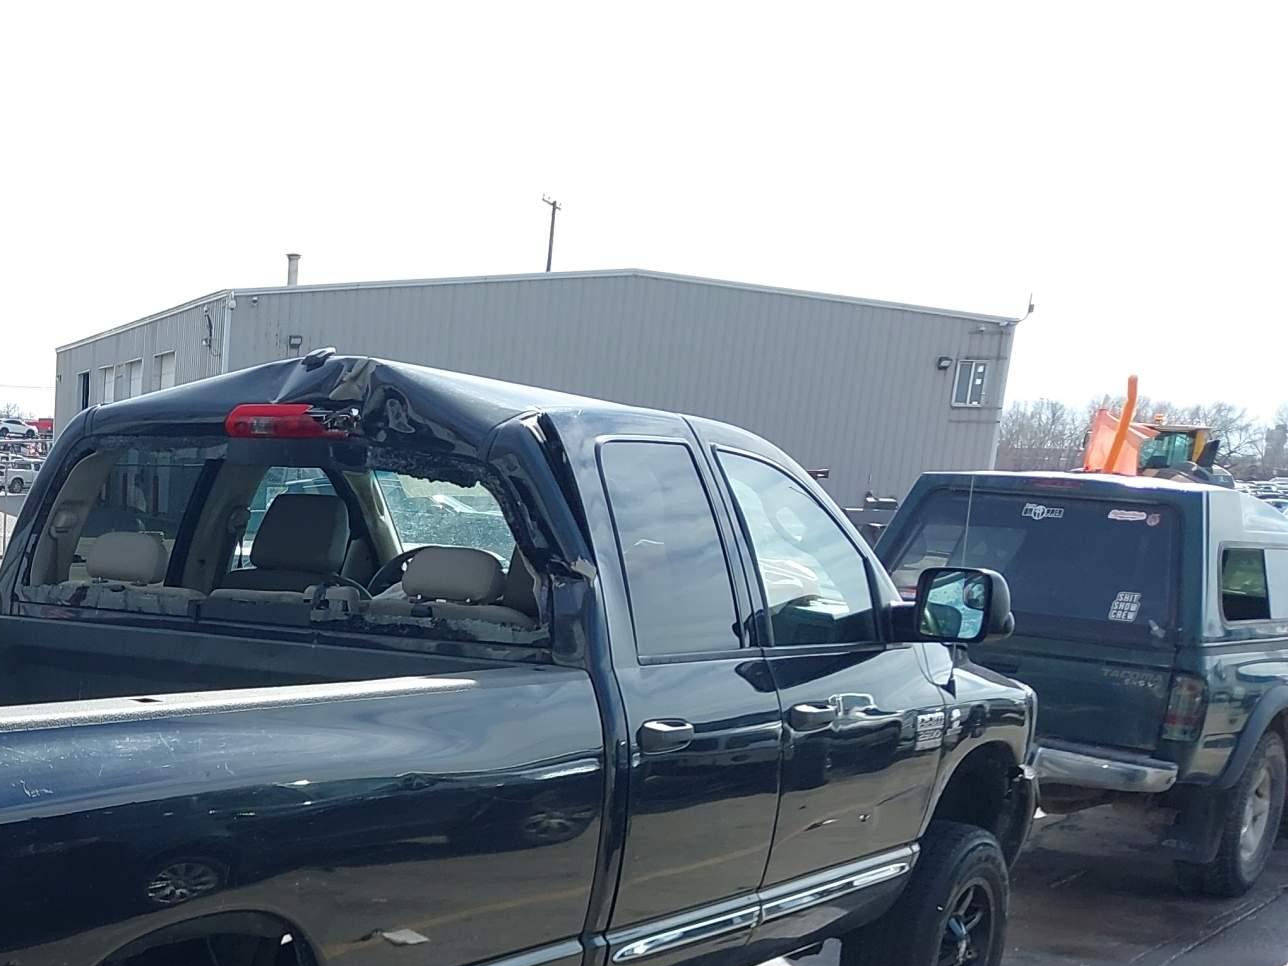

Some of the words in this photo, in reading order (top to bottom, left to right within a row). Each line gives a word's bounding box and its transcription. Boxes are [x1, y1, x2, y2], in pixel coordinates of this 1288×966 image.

[1118, 592, 1140, 602] SHIT
[1113, 601, 1138, 611] SHOW
[1111, 610, 1135, 620] CREW
[1101, 667, 1162, 685] TACOMA
